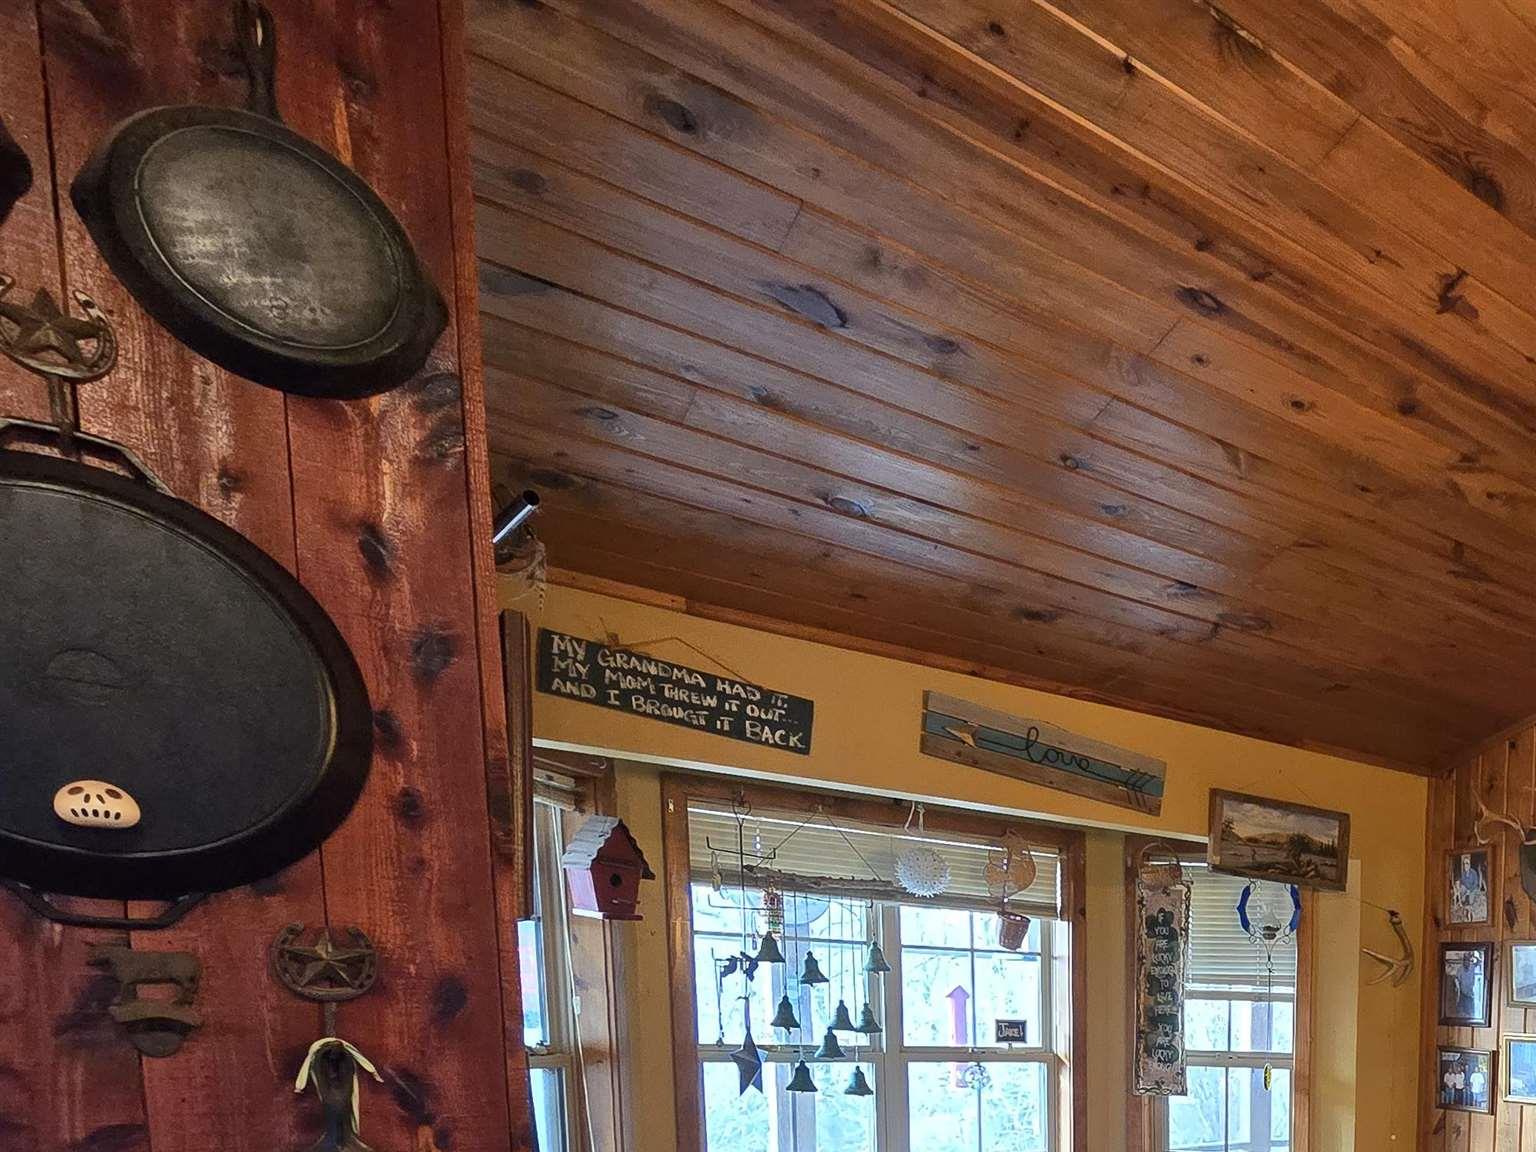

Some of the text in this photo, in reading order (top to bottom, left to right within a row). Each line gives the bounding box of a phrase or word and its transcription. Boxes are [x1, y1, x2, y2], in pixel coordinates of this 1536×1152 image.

[552, 634, 586, 661] MY
[597, 648, 706, 688] GRANDMA
[716, 678, 761, 701] HAD
[552, 655, 591, 680] MY
[604, 668, 657, 695] MOM
[660, 683, 718, 708] THREW
[725, 700, 741, 712] IT
[551, 677, 597, 698] AND
[606, 689, 621, 705] I
[716, 717, 735, 731] IT
[745, 720, 806, 749] BACK
[1026, 726, 1090, 772] love
[1154, 926, 1169, 936] YOU
